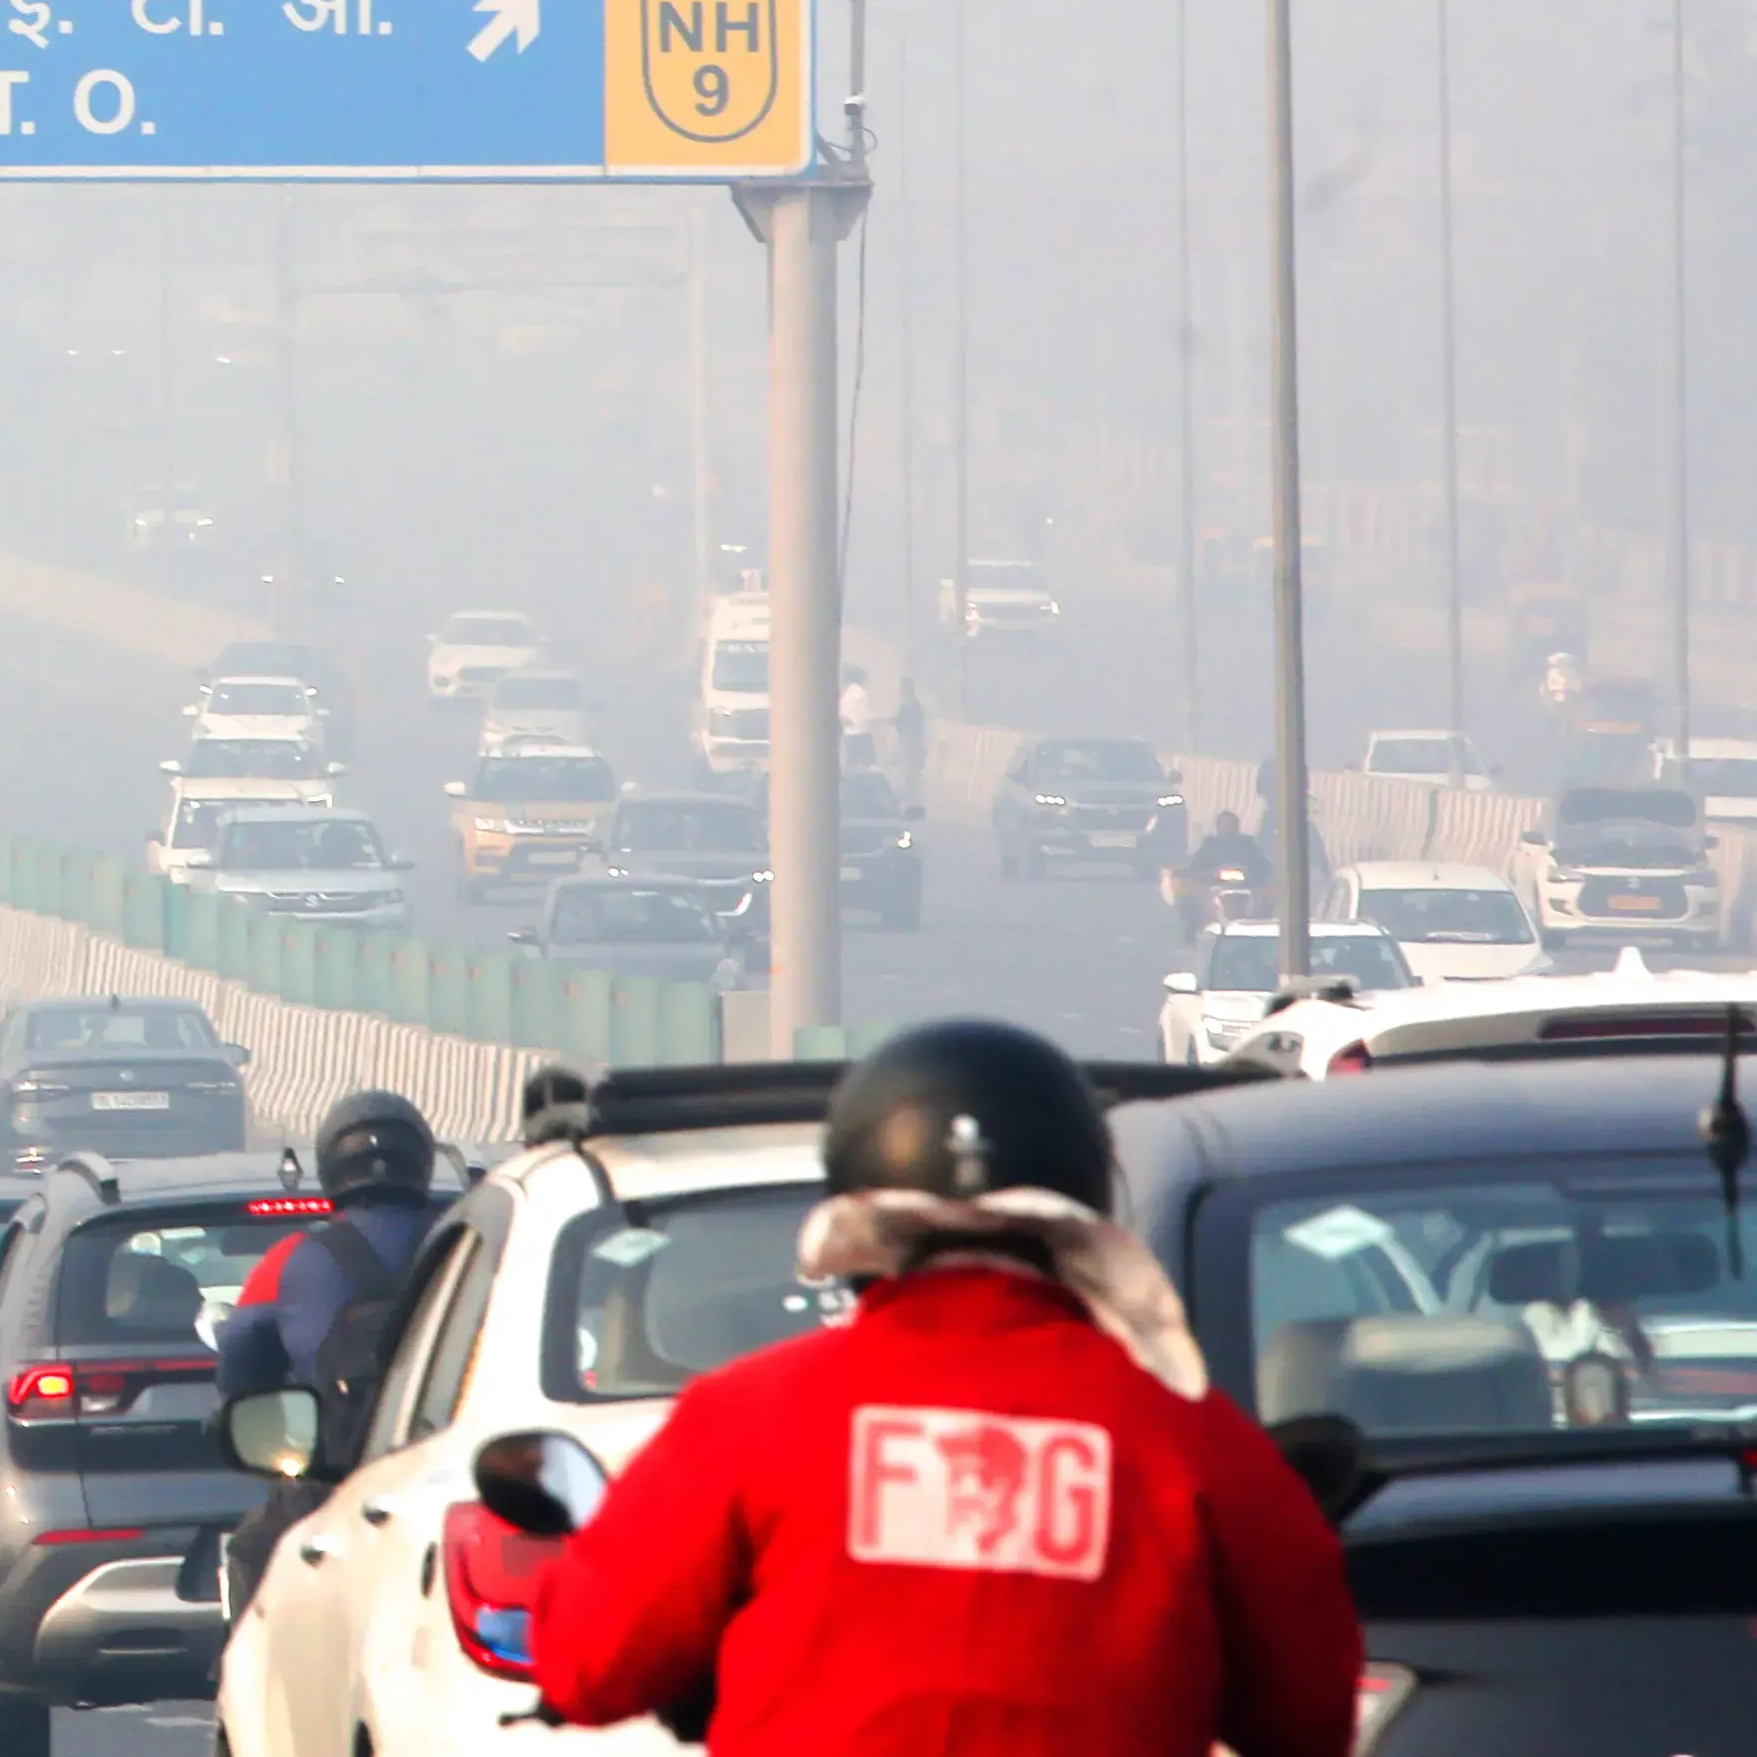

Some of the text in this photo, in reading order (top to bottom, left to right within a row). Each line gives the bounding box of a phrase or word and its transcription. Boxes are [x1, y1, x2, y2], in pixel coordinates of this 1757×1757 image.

[660, 2, 758, 53] NH
[73, 68, 156, 135] O.
[694, 67, 726, 114] 9
